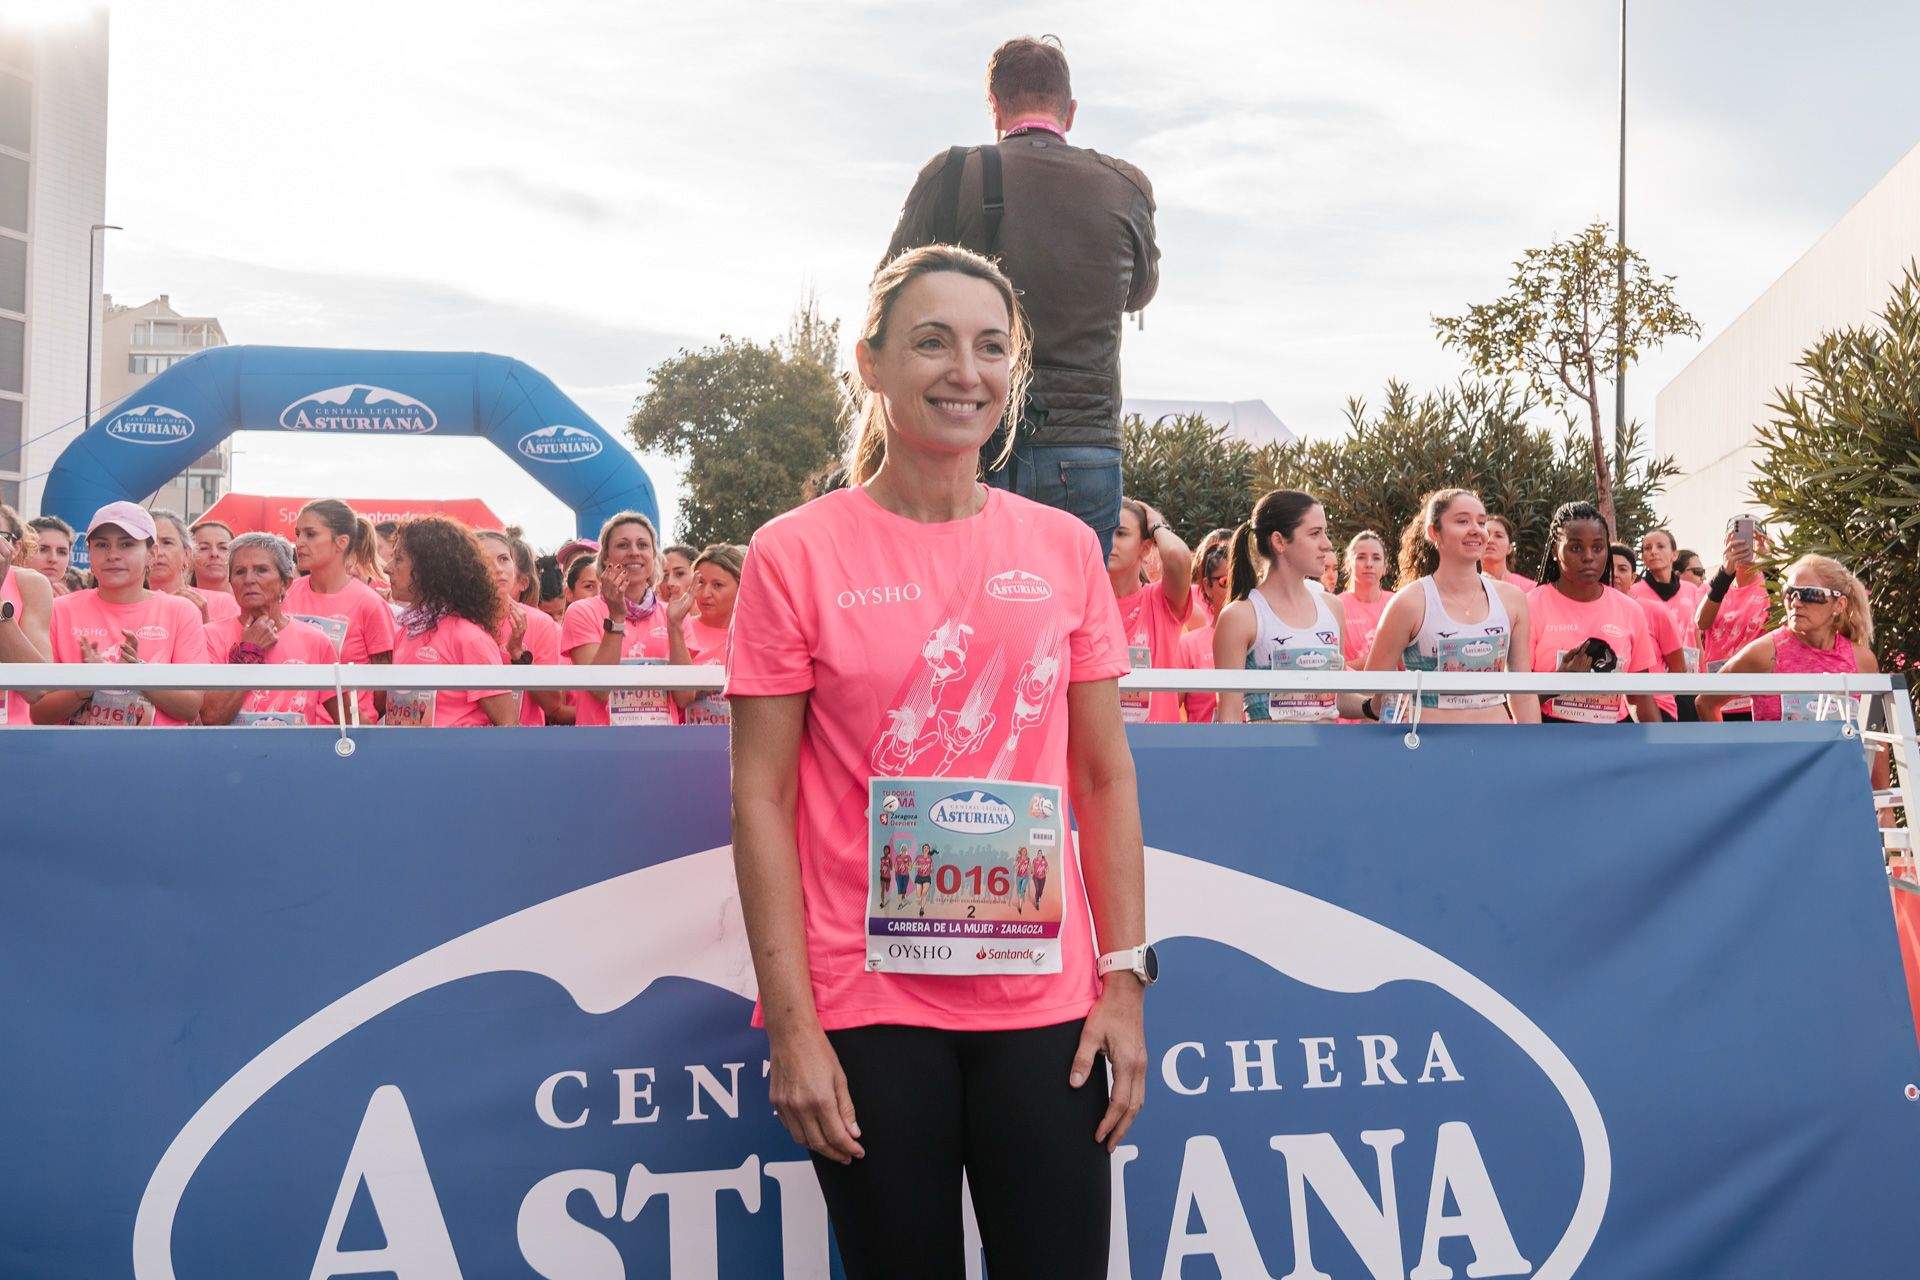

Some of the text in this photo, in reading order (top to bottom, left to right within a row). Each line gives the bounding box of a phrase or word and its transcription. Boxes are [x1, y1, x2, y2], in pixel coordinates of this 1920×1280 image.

[315, 407, 420, 416] CENTRAL LECHERA
[112, 419, 188, 436] ASTURIANA
[293, 409, 427, 431] ASTURIANA
[524, 439, 598, 454] ASTURIANA
[837, 582, 922, 609] OYSHO
[991, 582, 1051, 595] ASTURIANA
[92, 704, 125, 722] 016
[392, 704, 411, 718] 016
[890, 812, 918, 821] Zaragoza
[936, 805, 1010, 825] ASTURIANA
[936, 864, 1010, 896] 016
[966, 905, 976, 918] 2
[887, 921, 1044, 935] CARRERA DE LA MUJER ZARAGOZA
[888, 943, 952, 960] OYSHO
